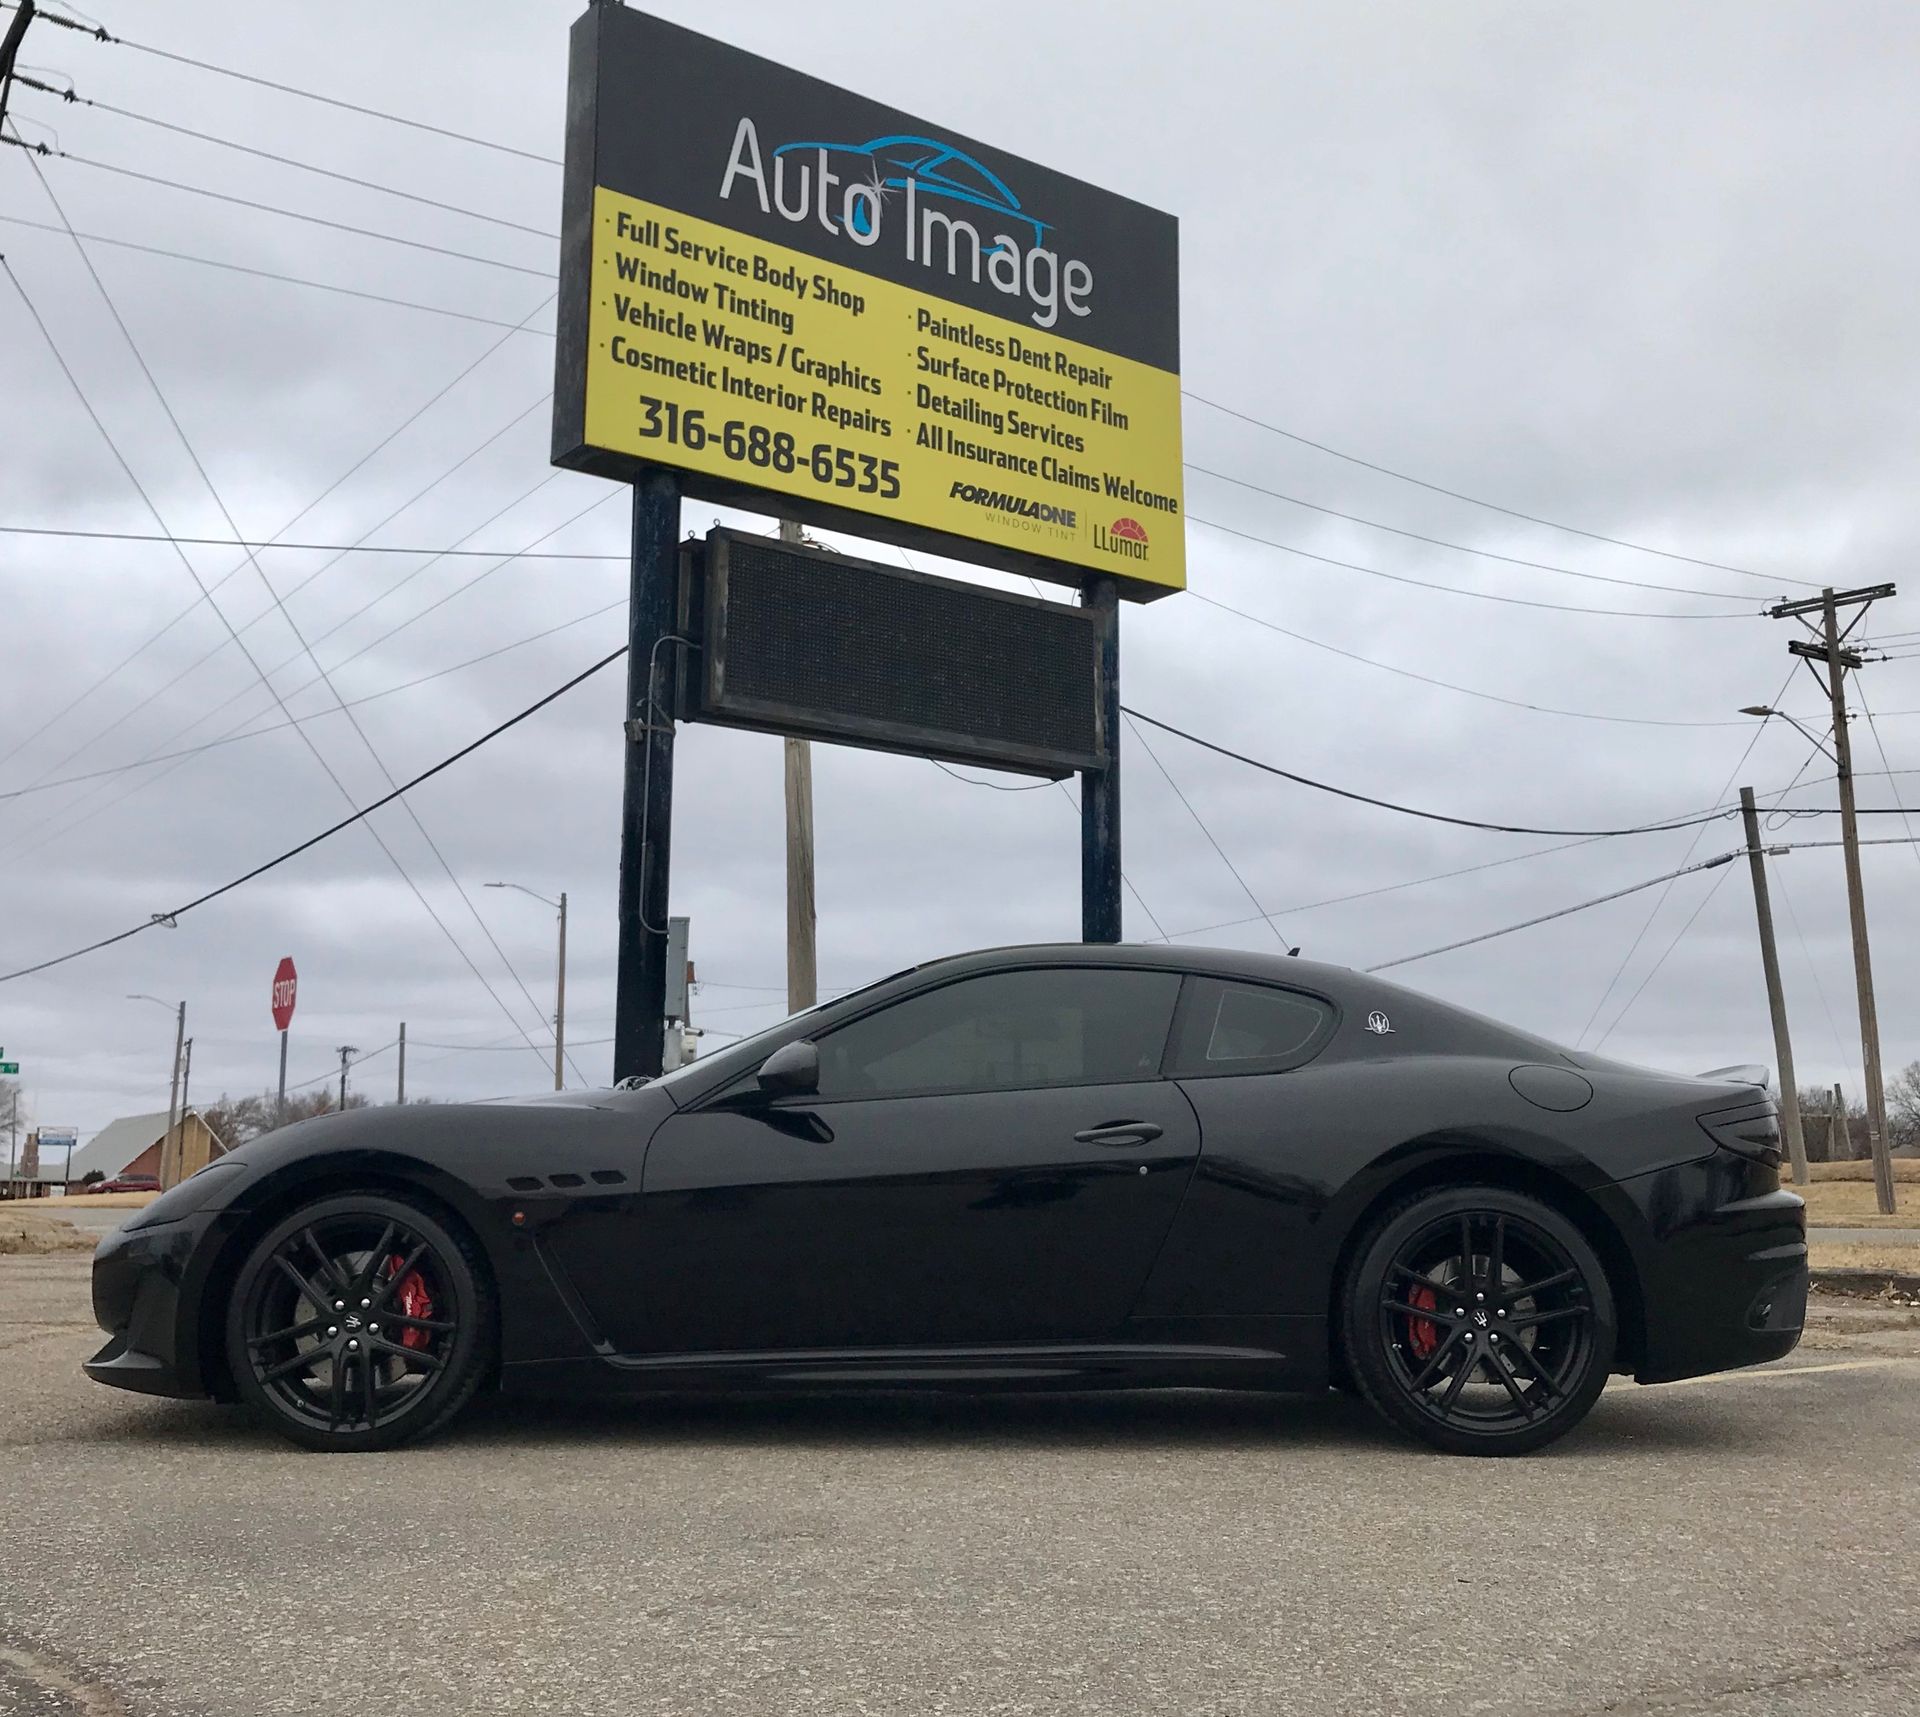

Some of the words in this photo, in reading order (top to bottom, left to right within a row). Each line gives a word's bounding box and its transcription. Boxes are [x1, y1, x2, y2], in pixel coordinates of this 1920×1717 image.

[617, 211, 660, 249] Full
[664, 227, 748, 277] Service
[753, 255, 808, 299] Body
[813, 274, 865, 316] Shop
[720, 117, 880, 246] Auto
[906, 177, 1093, 328] Image
[616, 252, 709, 304] Window
[714, 282, 794, 335] Tinting
[611, 335, 717, 389] Cosmetic
[722, 366, 807, 413] Interior
[812, 391, 891, 437] Repairs
[614, 293, 697, 342] Vehicle
[702, 319, 773, 364] Wraps
[776, 343, 787, 367] /
[791, 347, 882, 395] Graphics
[917, 308, 1005, 357] Paintless
[1009, 337, 1051, 372] Dent
[1055, 351, 1113, 390] Repair
[917, 346, 990, 389] Surface
[994, 368, 1087, 418] Protection
[1091, 398, 1129, 430] Film
[917, 384, 1004, 435] Detailing
[1007, 410, 1085, 453] Services
[639, 395, 901, 499] 316-688-6535
[916, 422, 943, 451] All
[947, 429, 1038, 477] Insurance
[1041, 455, 1100, 493] Claims
[1103, 472, 1178, 514] Welcome
[985, 511, 1042, 534] WINDOW
[1048, 526, 1076, 541] TINT
[1093, 523, 1149, 561] LLumar
[273, 979, 296, 1009] STOP
